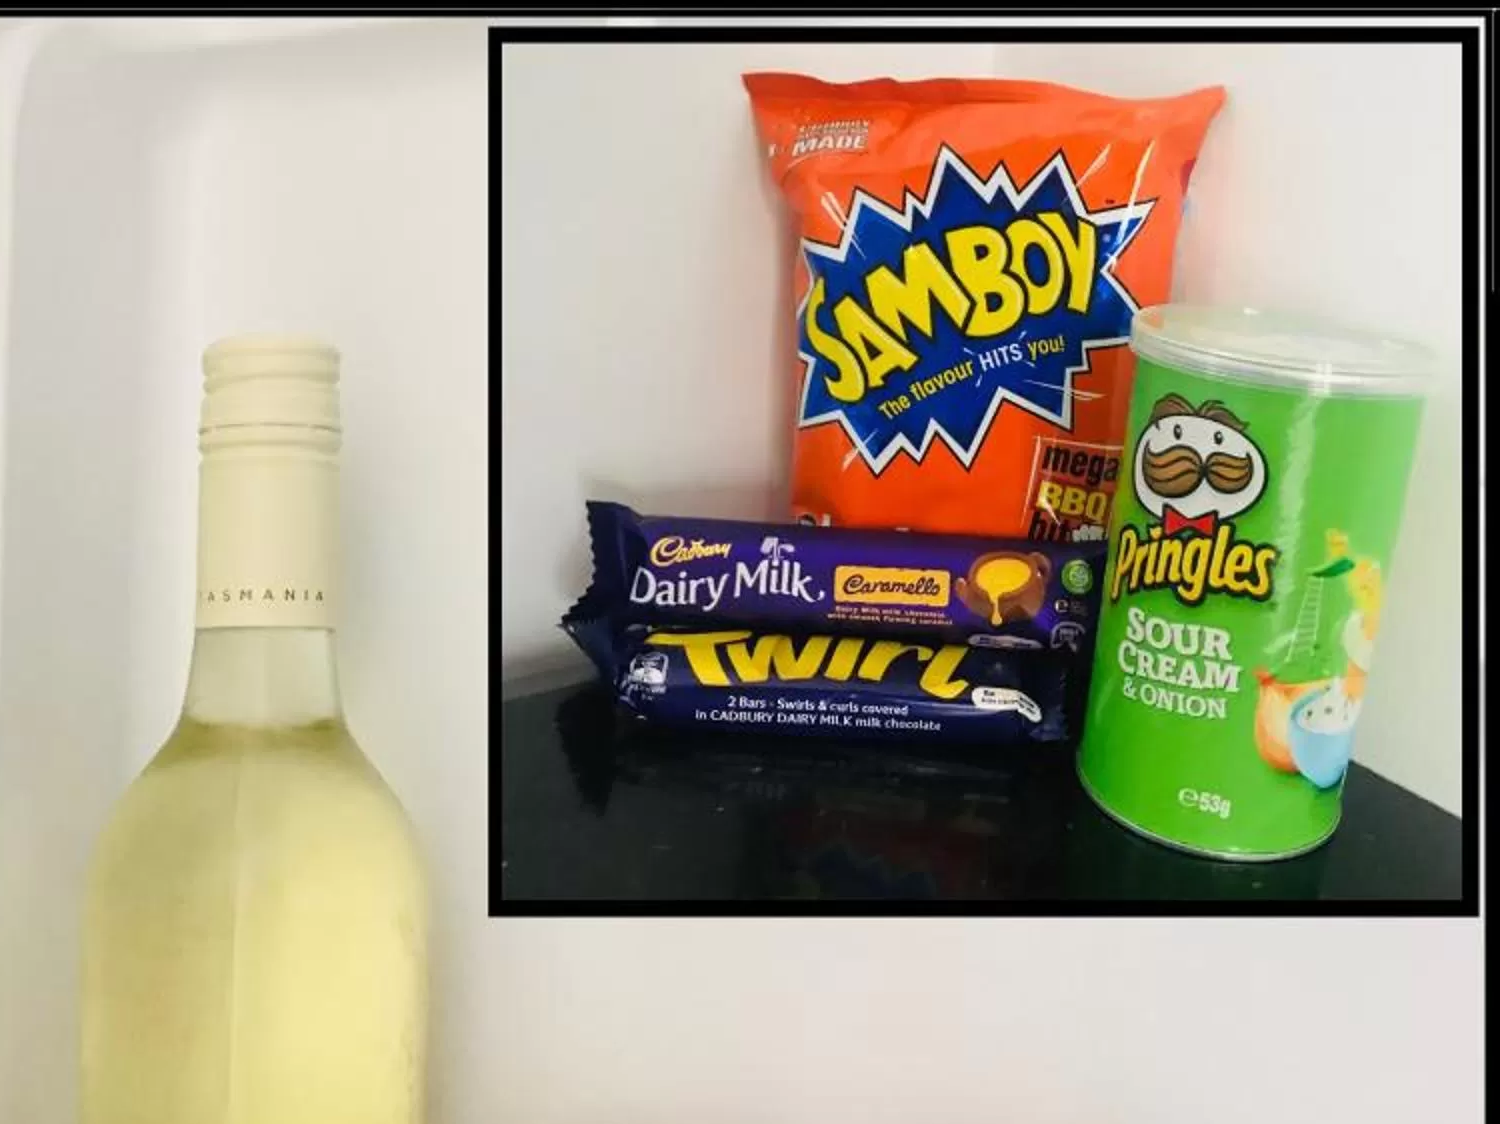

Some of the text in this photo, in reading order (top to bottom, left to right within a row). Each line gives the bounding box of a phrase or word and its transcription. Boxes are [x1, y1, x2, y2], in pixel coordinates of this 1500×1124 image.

[805, 211, 1097, 403] SAMBOY
[878, 335, 1066, 420] The flavour HITS you!
[1042, 445, 1121, 486] mega
[1036, 480, 1108, 523] BBQ
[650, 536, 732, 567] Cadbury
[1111, 525, 1278, 604] Pringles
[630, 566, 730, 612] Dairy
[842, 573, 941, 597] Caramello
[1126, 607, 1232, 661] SOUR
[1118, 640, 1241, 692] CREAM
[727, 695, 737, 708] 2
[739, 697, 766, 709] Bars
[777, 698, 815, 712] Swirls
[829, 700, 859, 714] curls
[861, 703, 909, 717] covered
[1123, 676, 1228, 720] & ONION
[695, 709, 942, 732] in CADBURY DAIRY MILK milk chocolate
